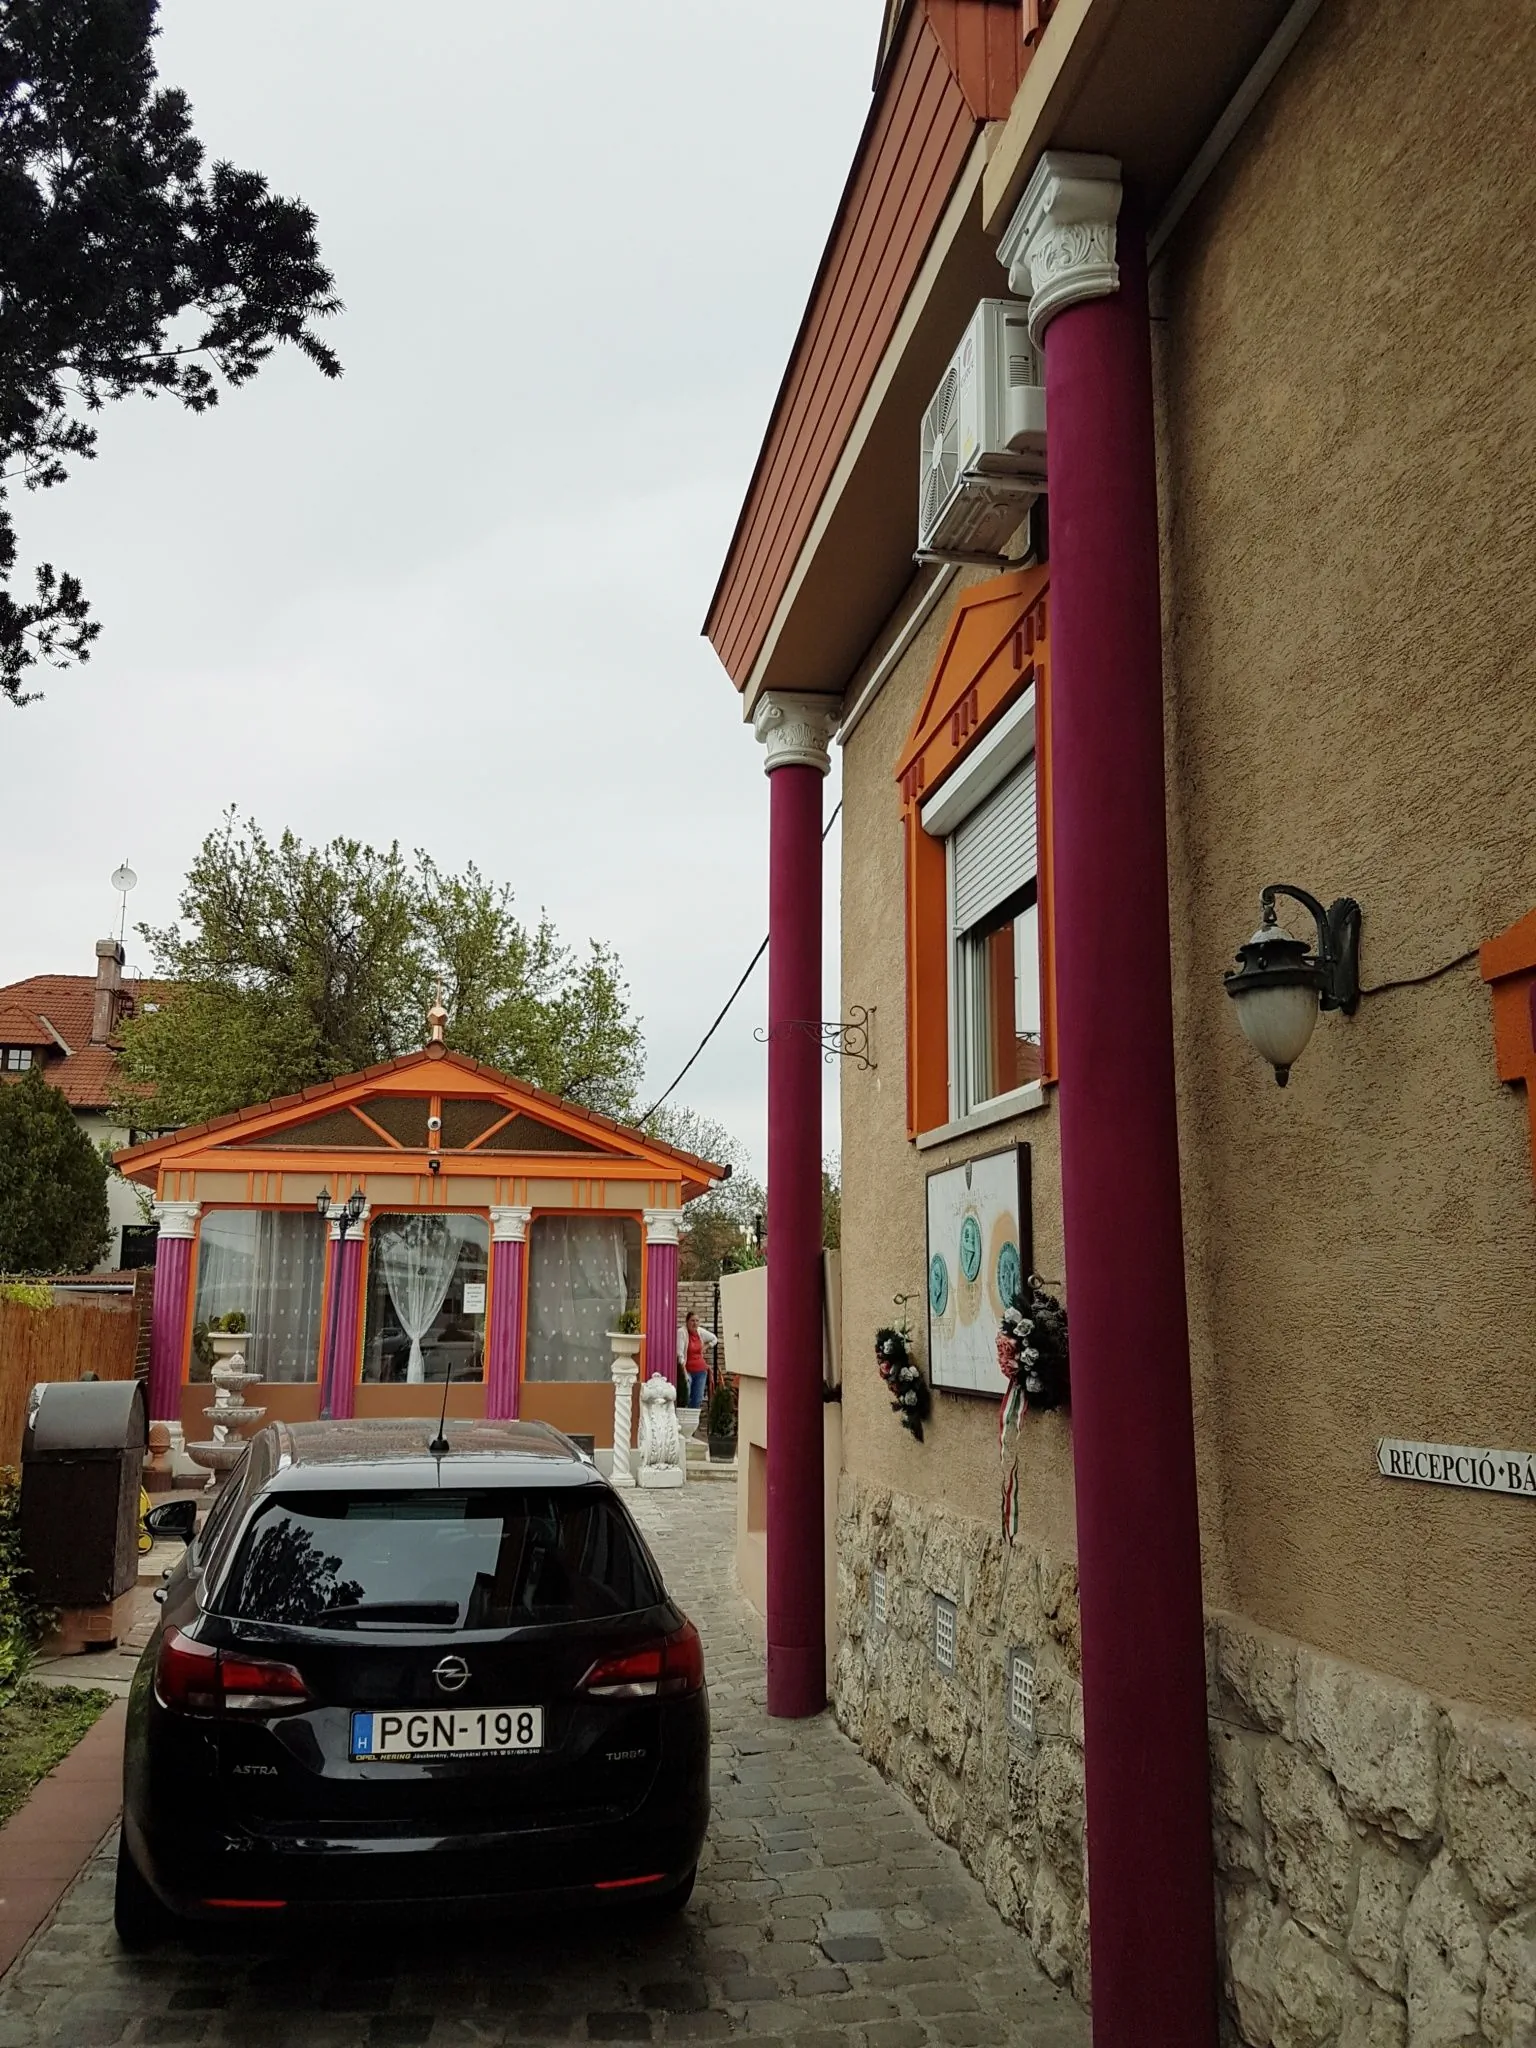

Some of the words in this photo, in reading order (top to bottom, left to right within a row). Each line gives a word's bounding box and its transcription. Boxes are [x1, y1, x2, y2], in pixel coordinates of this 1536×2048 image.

[1388, 1449, 1496, 1488] RECEPCIÓ
[358, 1737, 367, 1749] H
[380, 1713, 534, 1749] PGN-198
[605, 1749, 647, 1761] TURBO
[232, 1764, 279, 1776] ASTRA
